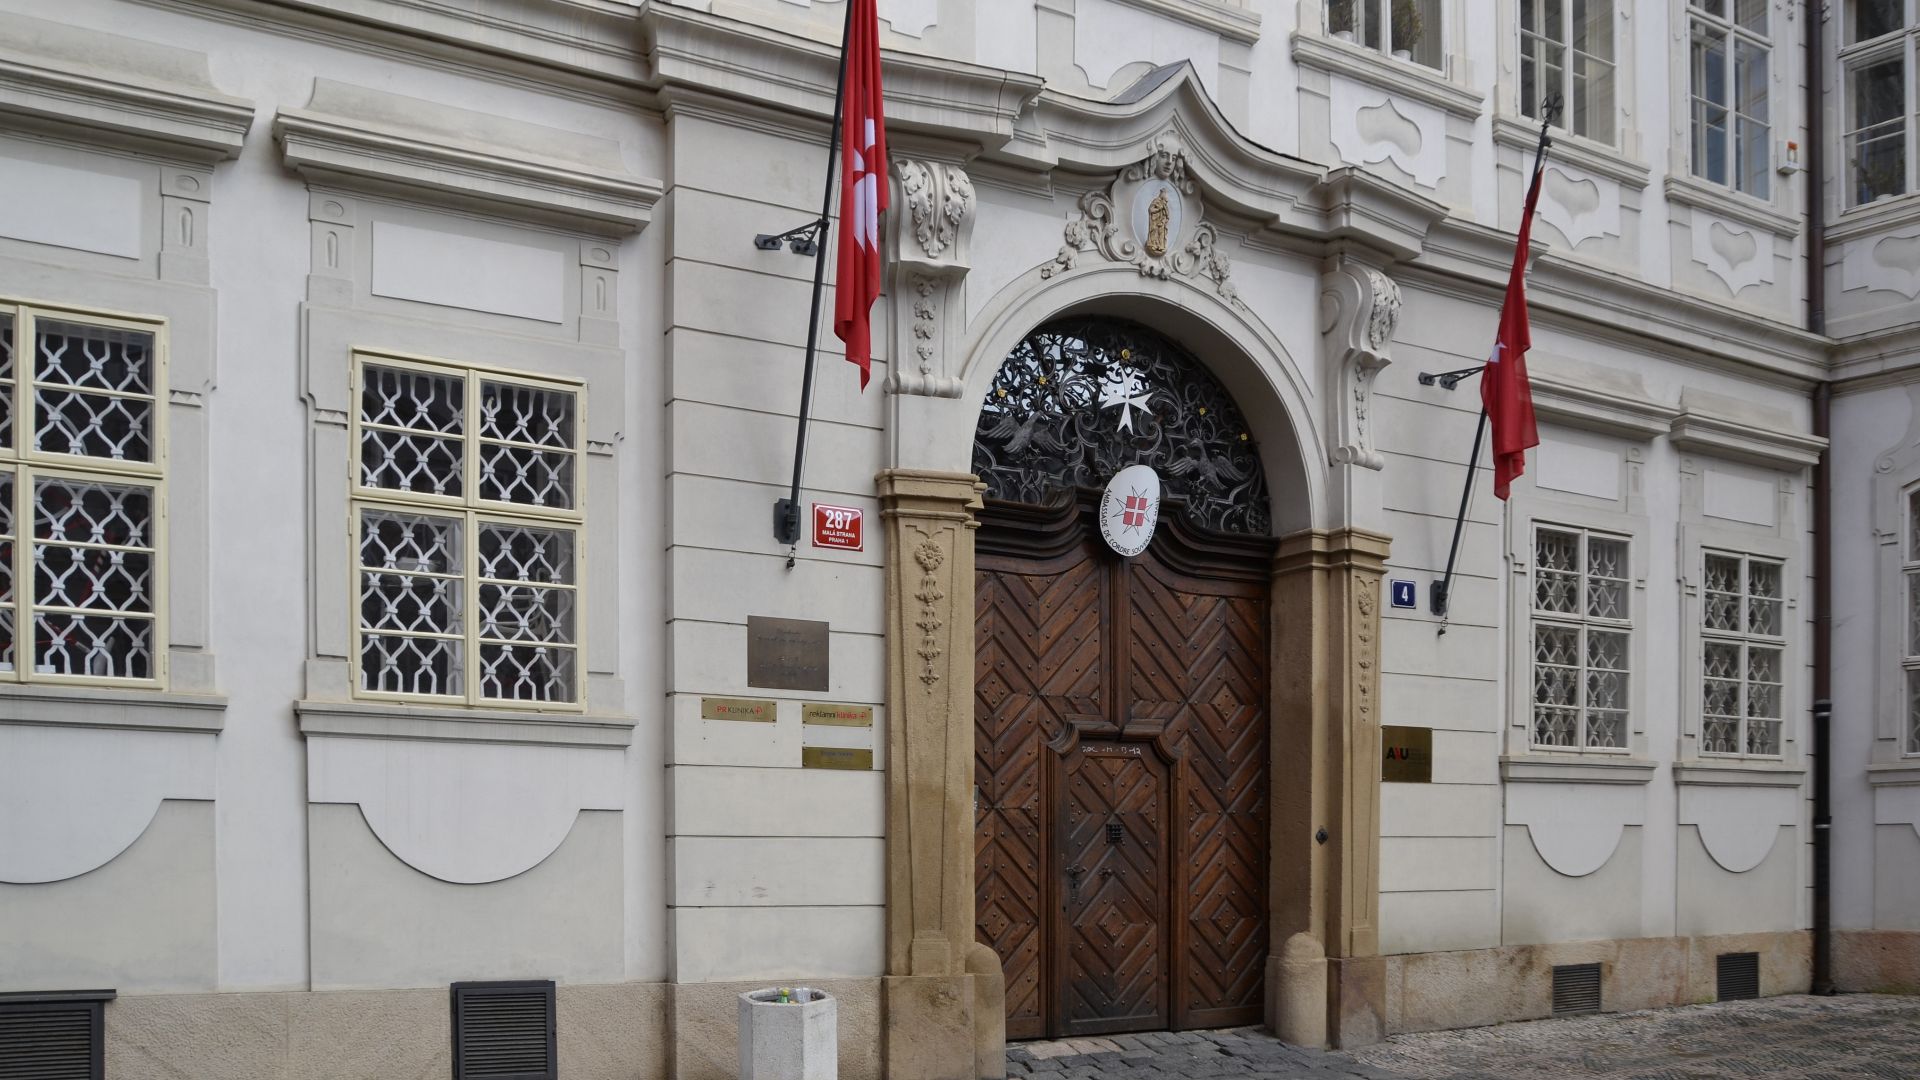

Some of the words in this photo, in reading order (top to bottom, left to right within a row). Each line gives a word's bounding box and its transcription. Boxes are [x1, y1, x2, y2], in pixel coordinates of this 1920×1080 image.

[1101, 488, 1112, 527] AMBASSADE
[825, 509, 852, 530] 287
[1103, 530, 1111, 538] DE
[1131, 529, 1153, 555] SOUVERAIN
[1401, 586, 1409, 602] 4
[727, 706, 755, 715] KLINIKA
